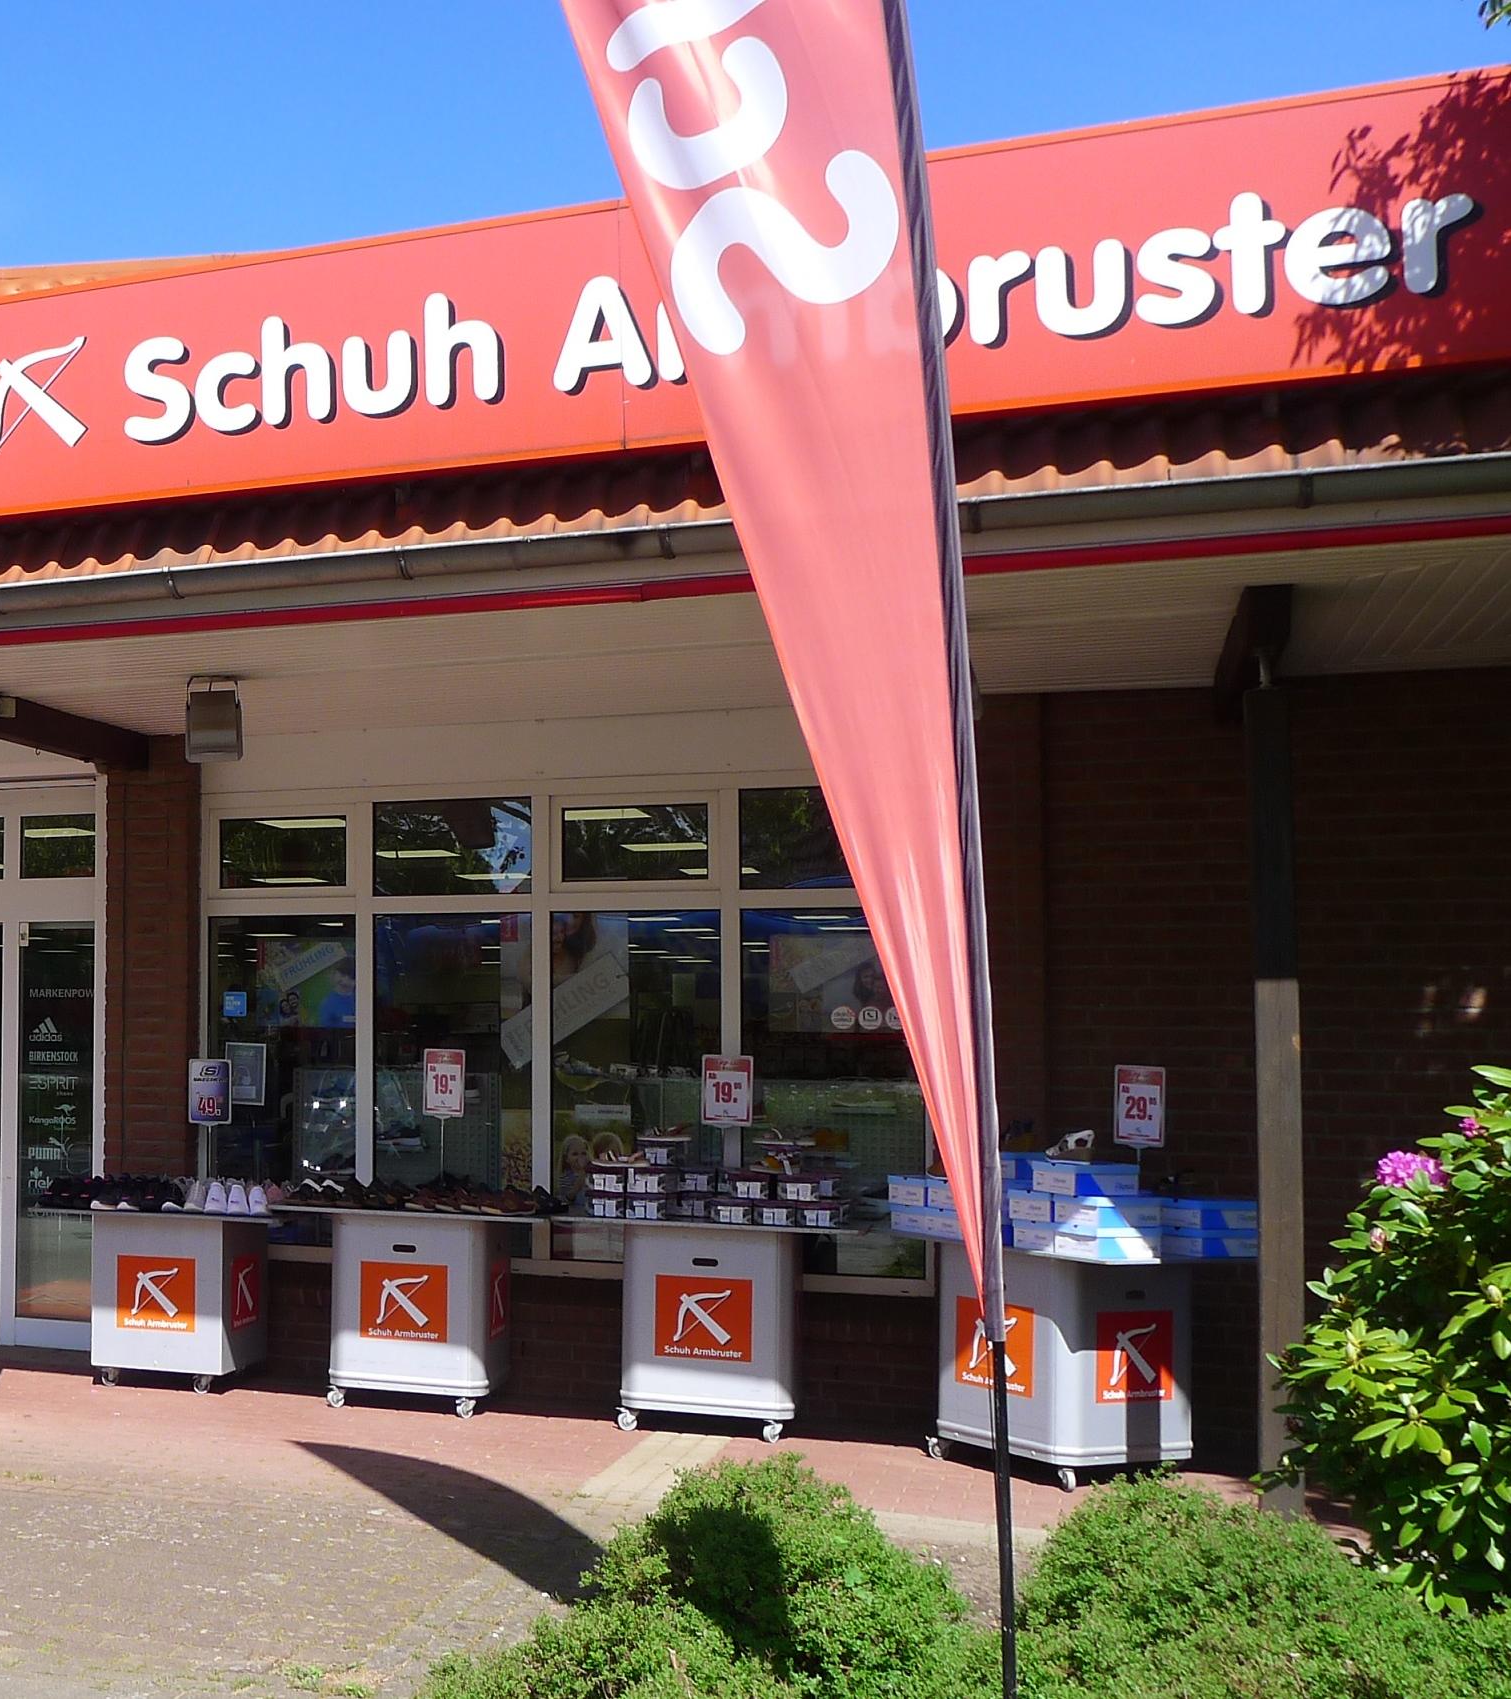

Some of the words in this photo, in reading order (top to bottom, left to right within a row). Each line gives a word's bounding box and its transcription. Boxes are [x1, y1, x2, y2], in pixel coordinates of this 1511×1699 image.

[123, 292, 505, 444] Schuh
[28, 1033, 63, 1042] adidas
[29, 1051, 79, 1062] BIRKENSTOCK
[28, 1075, 79, 1090] ESPRIT
[28, 1115, 77, 1126] KangaROOS
[28, 1147, 61, 1160] PUMA
[368, 1327, 392, 1337] Schuh
[393, 1328, 439, 1340] Armbruster
[664, 1345, 691, 1355] Schuh
[693, 1347, 743, 1359] Armbruster
